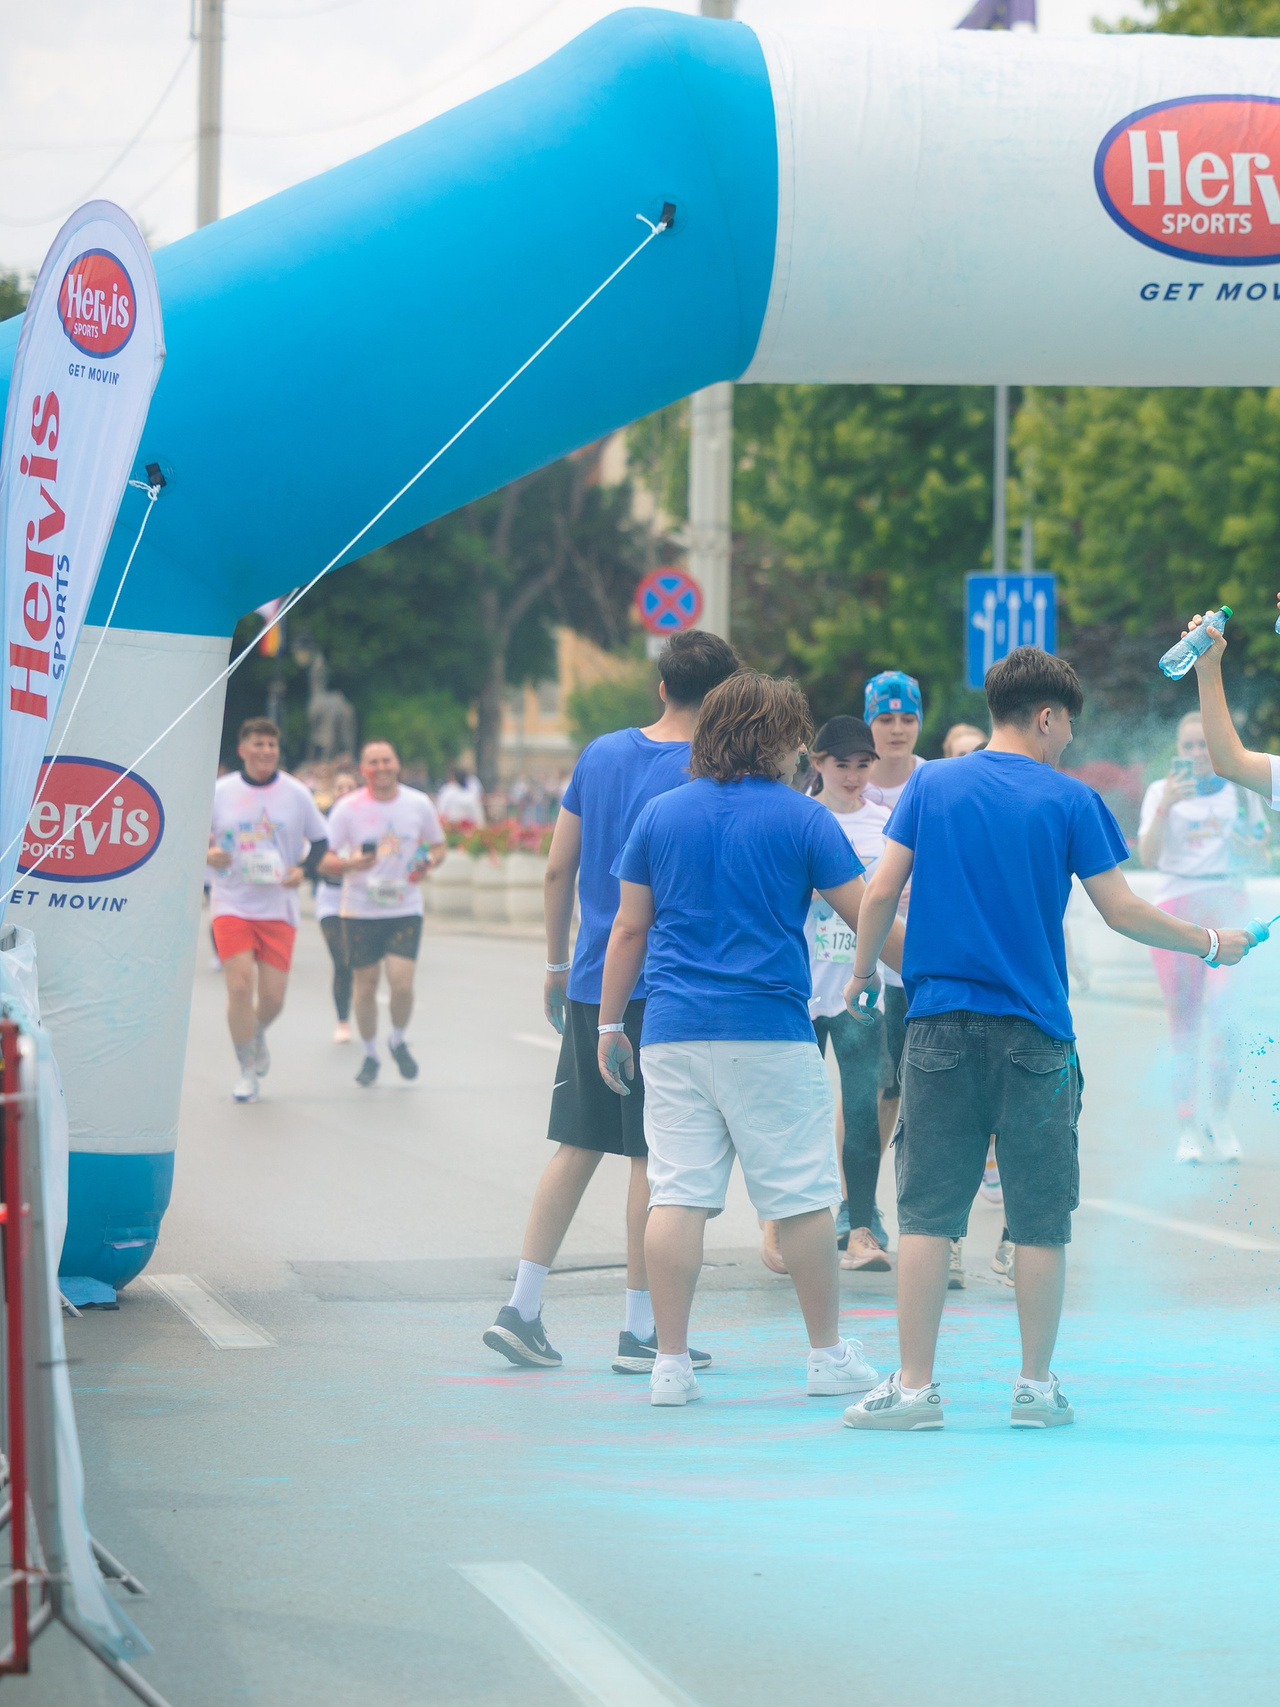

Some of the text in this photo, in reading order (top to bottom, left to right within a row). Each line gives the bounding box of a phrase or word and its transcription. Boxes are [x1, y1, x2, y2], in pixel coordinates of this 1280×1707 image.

[1161, 213, 1253, 235] SPORTS
[1139, 282, 1204, 301] GET
[66, 273, 130, 336] Hervis
[73, 322, 99, 339] SPORTS
[68, 362, 86, 378] GET
[9, 390, 66, 722] Hervis
[52, 553, 70, 681] SPORTS
[29, 795, 150, 856] ervis
[20, 842, 75, 860] PORTS
[10, 889, 128, 912] ET MOVIN'
[832, 932, 857, 951] 1734
